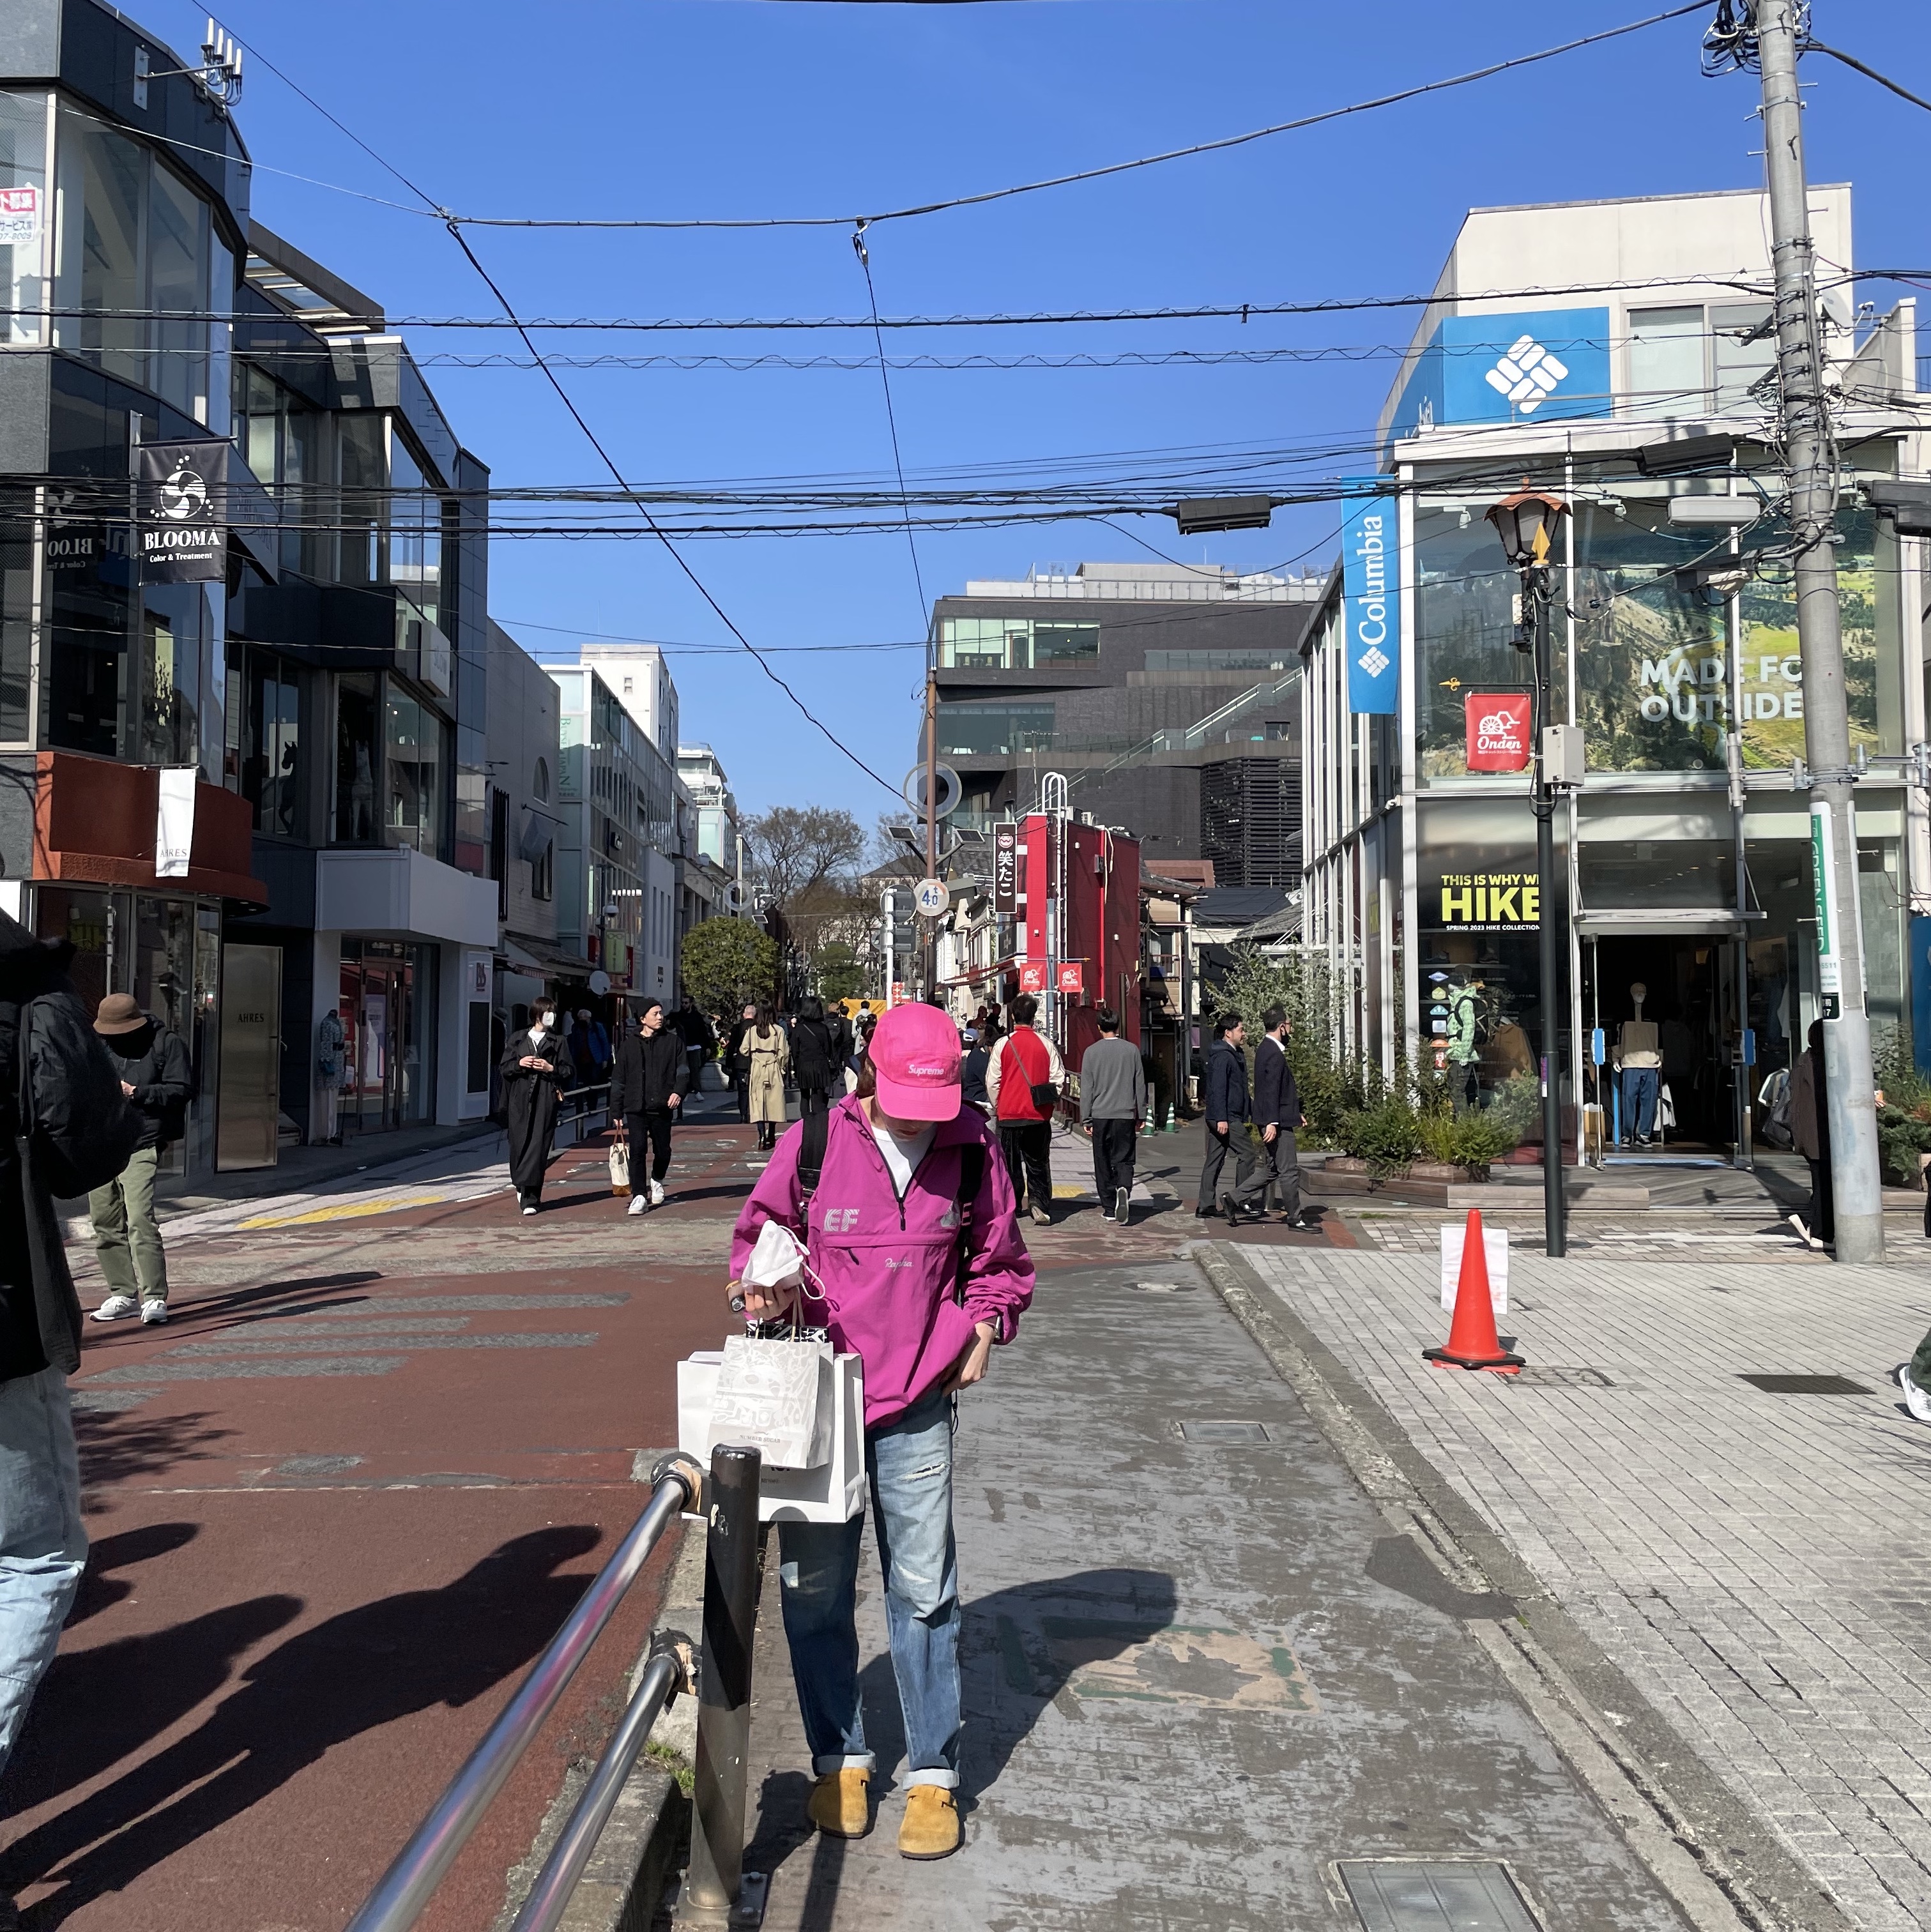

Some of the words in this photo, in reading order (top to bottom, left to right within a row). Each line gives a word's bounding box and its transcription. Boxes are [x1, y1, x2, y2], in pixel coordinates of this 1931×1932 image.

[144, 529, 221, 550] BLOOMA
[1357, 515, 1386, 645] Columbia
[1477, 736, 1522, 750] Onden
[160, 849, 187, 857] AHRES
[998, 851, 1014, 897] 笑たこ
[1441, 875, 1472, 886] THIS
[1474, 875, 1486, 885] IS
[1488, 874, 1521, 885] WHY
[1442, 887, 1540, 922] HIKE
[238, 1013, 264, 1023] AHRES
[908, 1064, 944, 1076] Supreme
[823, 1209, 860, 1231] EF
[885, 1258, 913, 1272] Rapha
